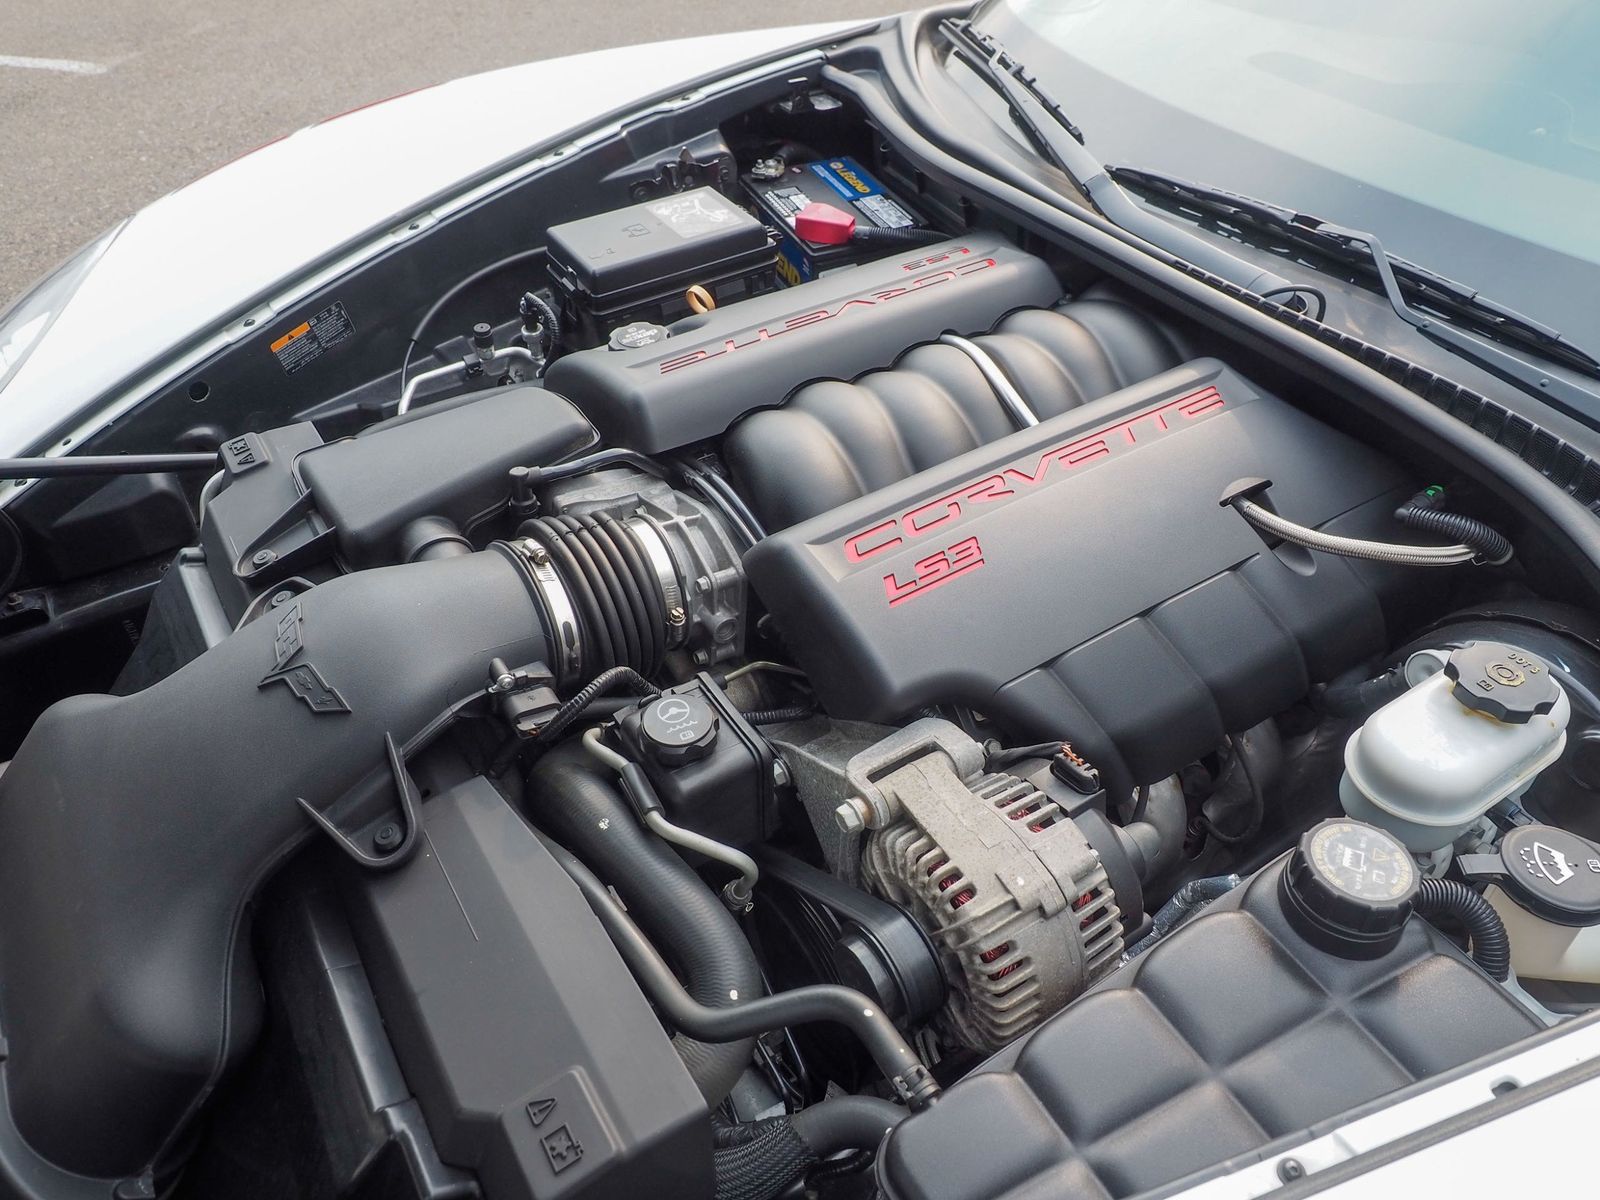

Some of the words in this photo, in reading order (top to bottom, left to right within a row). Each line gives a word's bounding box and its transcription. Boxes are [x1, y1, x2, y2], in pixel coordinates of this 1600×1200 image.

[659, 257, 997, 375] CORVETTE
[844, 384, 1225, 565] CORVETTE
[883, 535, 985, 601] LS3
[1507, 652, 1532, 668] DOT
